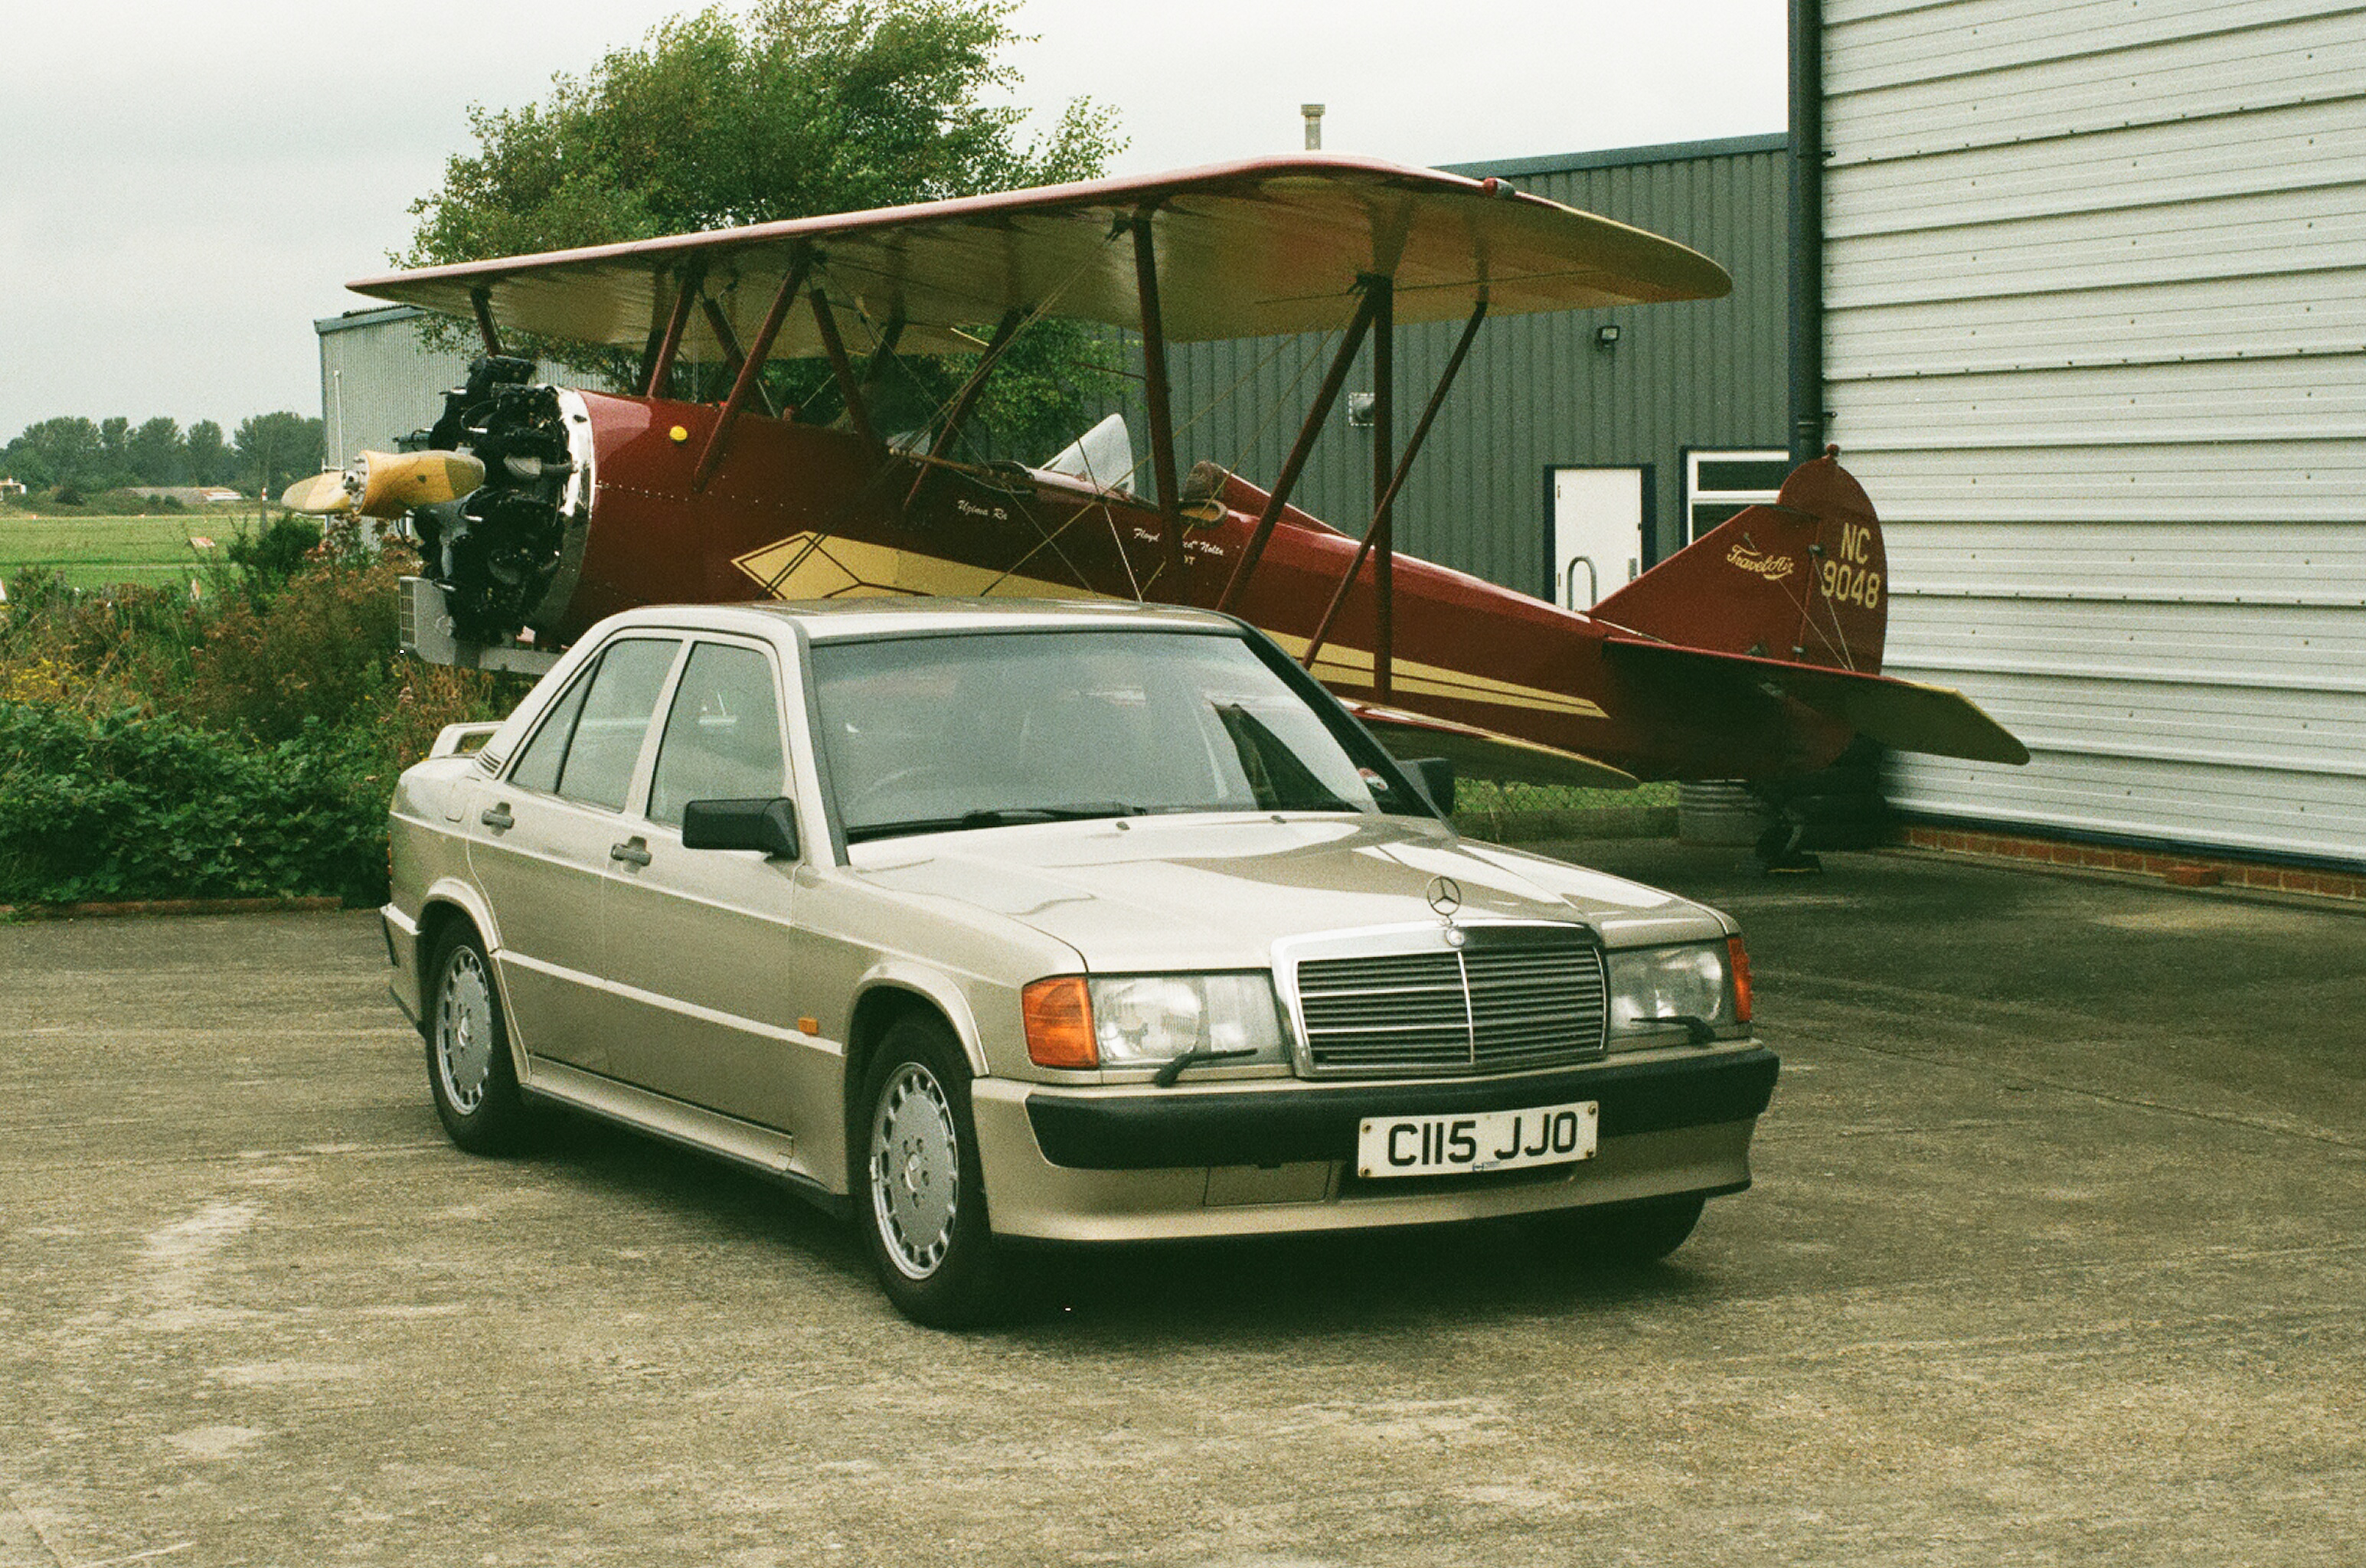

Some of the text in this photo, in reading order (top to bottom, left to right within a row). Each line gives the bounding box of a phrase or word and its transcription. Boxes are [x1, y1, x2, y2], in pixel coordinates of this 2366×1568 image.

[1133, 528, 1161, 543] Floyd
[1840, 522, 1871, 564] NC
[1821, 560, 1881, 609] 9048
[1387, 1110, 1578, 1167] C115 JJO
